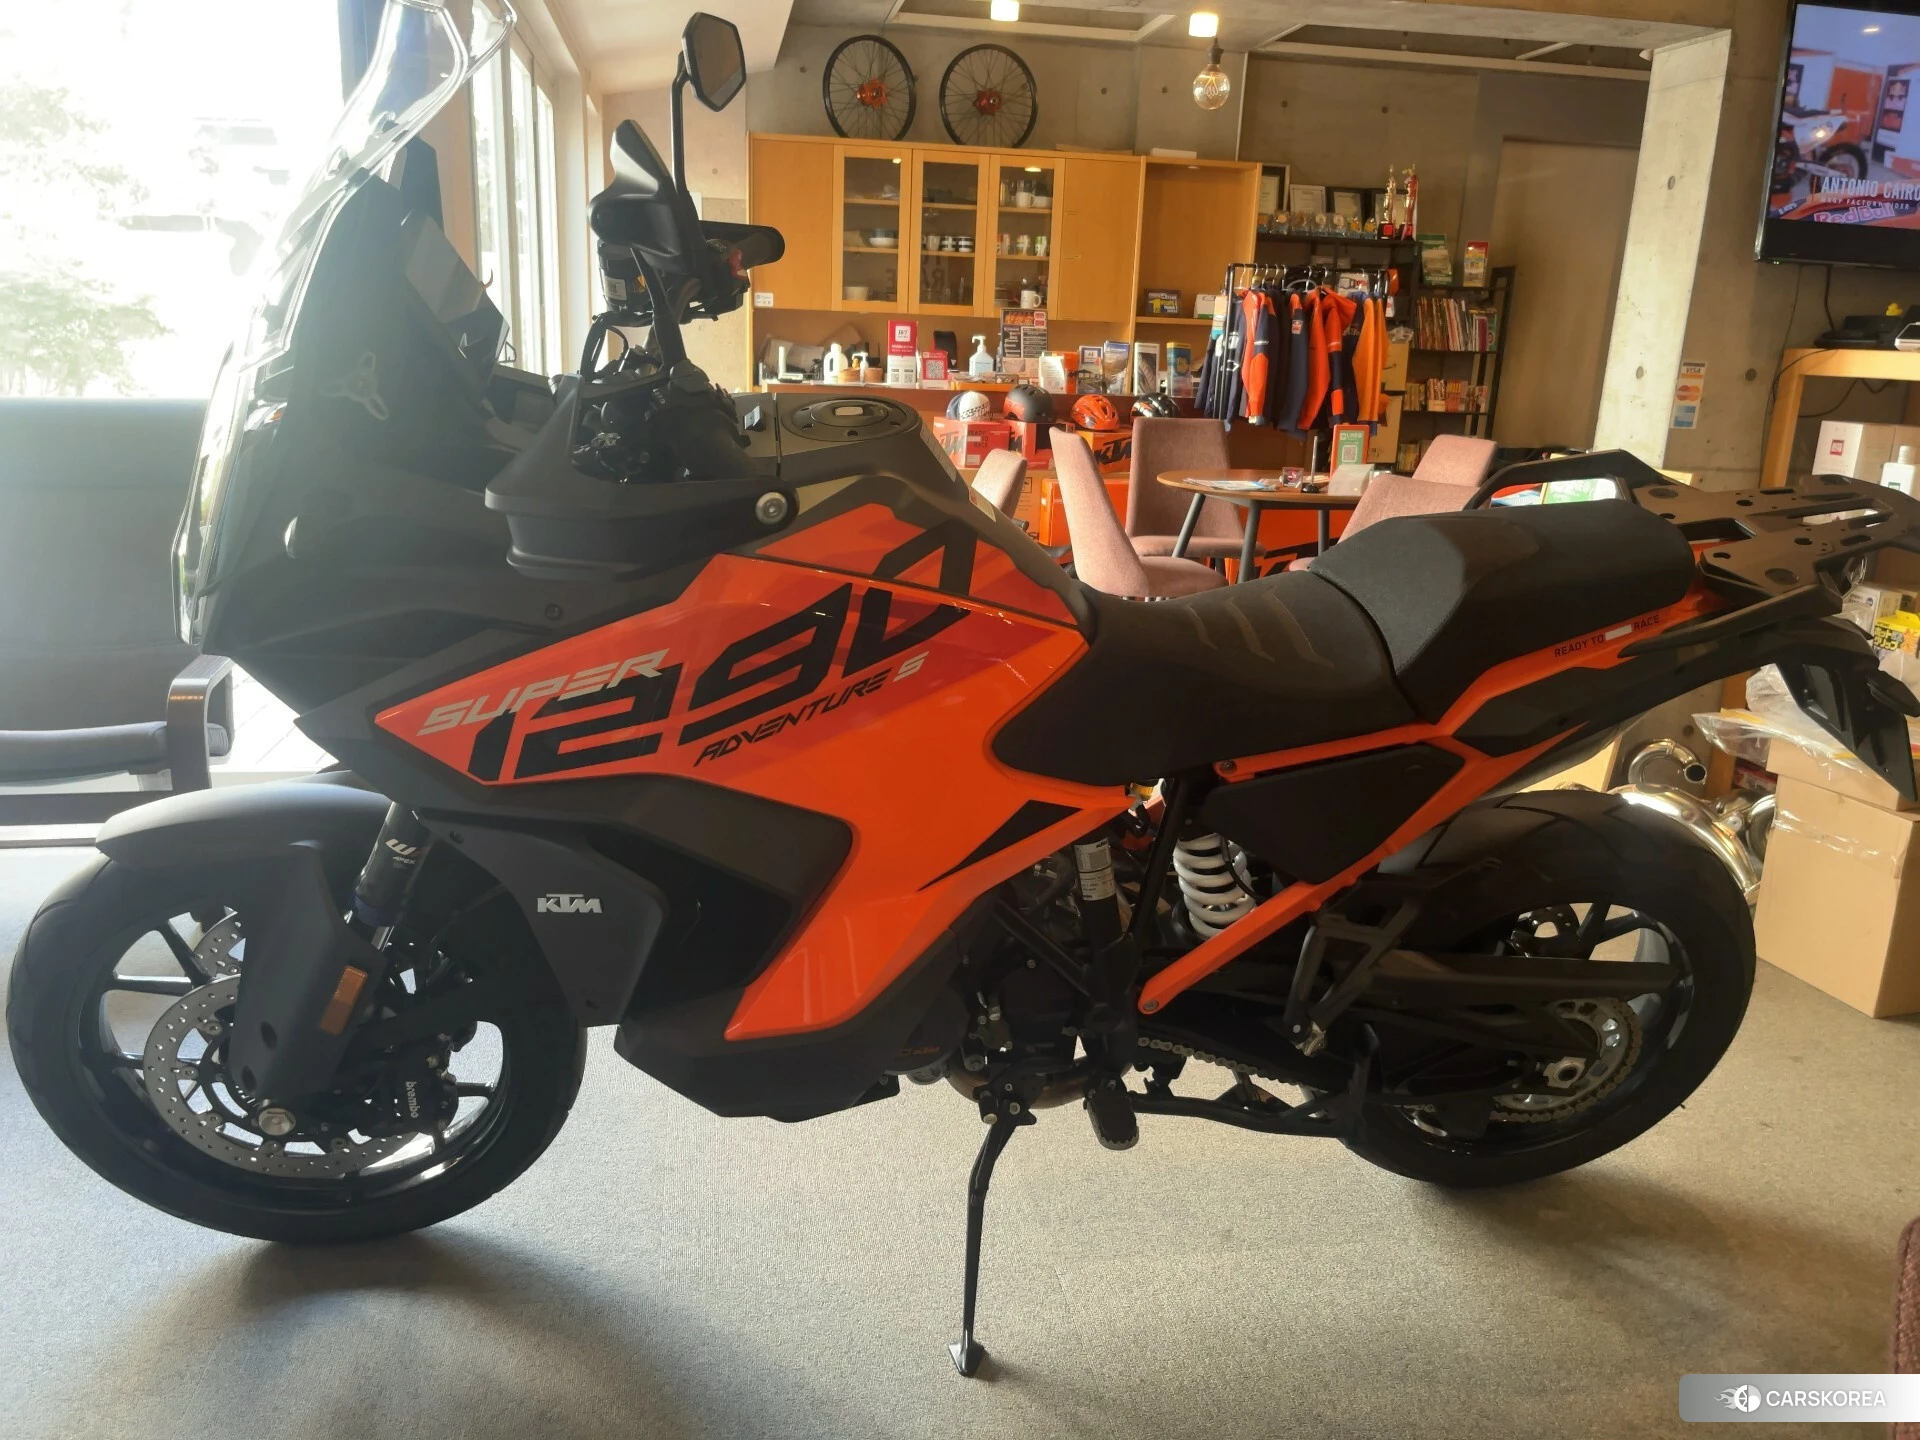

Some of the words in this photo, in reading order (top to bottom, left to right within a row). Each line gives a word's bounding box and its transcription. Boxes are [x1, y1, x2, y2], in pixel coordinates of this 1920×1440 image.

[1821, 176, 1879, 197] ANTONIO
[1859, 202, 1896, 222] Bull
[467, 520, 979, 781] 1290
[1554, 639, 1589, 658] READY
[1590, 634, 1605, 645] TO
[1633, 614, 1661, 631] RACE
[417, 648, 669, 736] SUPER
[693, 667, 892, 767] ADVENTURE
[892, 650, 930, 681] S
[537, 893, 603, 914] KTM
[405, 1081, 421, 1119] brembo
